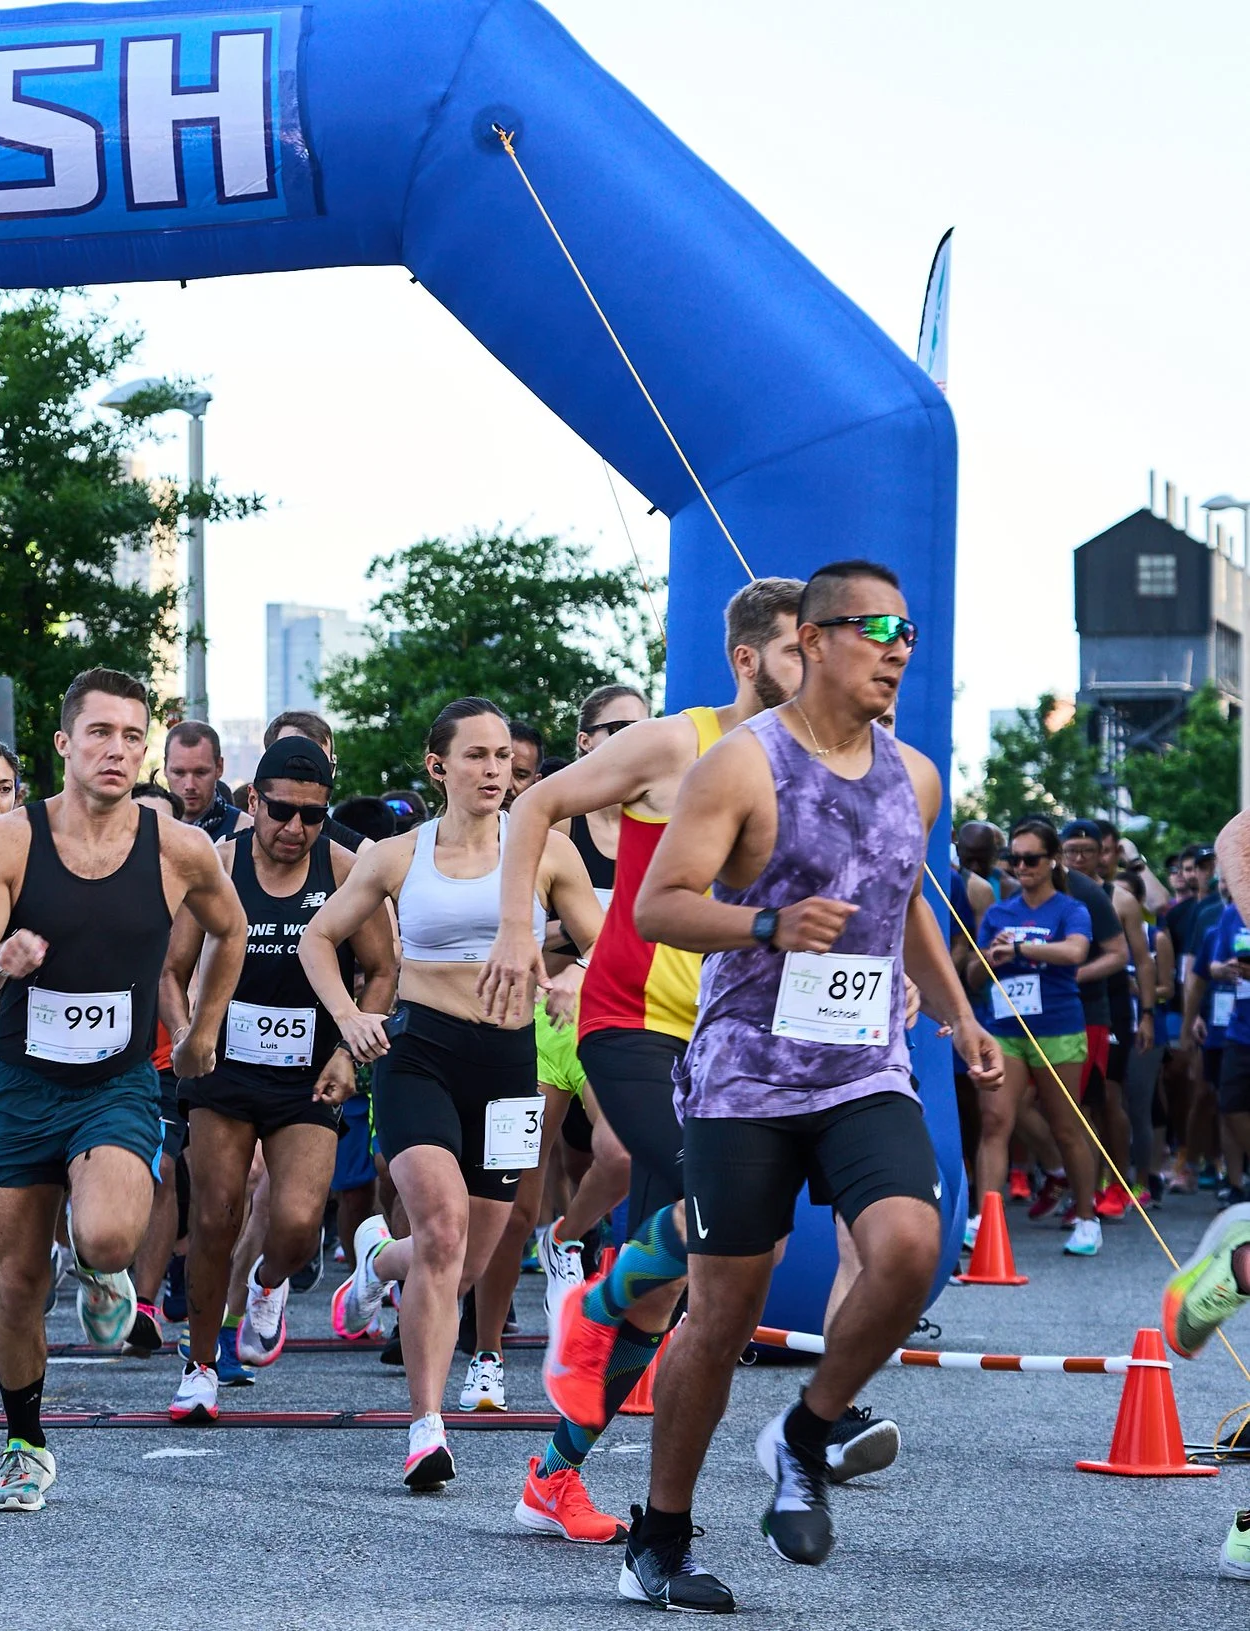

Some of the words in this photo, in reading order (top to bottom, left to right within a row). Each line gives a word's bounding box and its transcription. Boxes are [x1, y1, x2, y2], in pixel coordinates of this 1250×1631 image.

[245, 943, 284, 954] RACK
[828, 970, 883, 1001] 897
[64, 1005, 115, 1030] 991
[817, 1006, 861, 1019] Michael
[257, 1016, 306, 1039] 965
[260, 1040, 279, 1050] Luis
